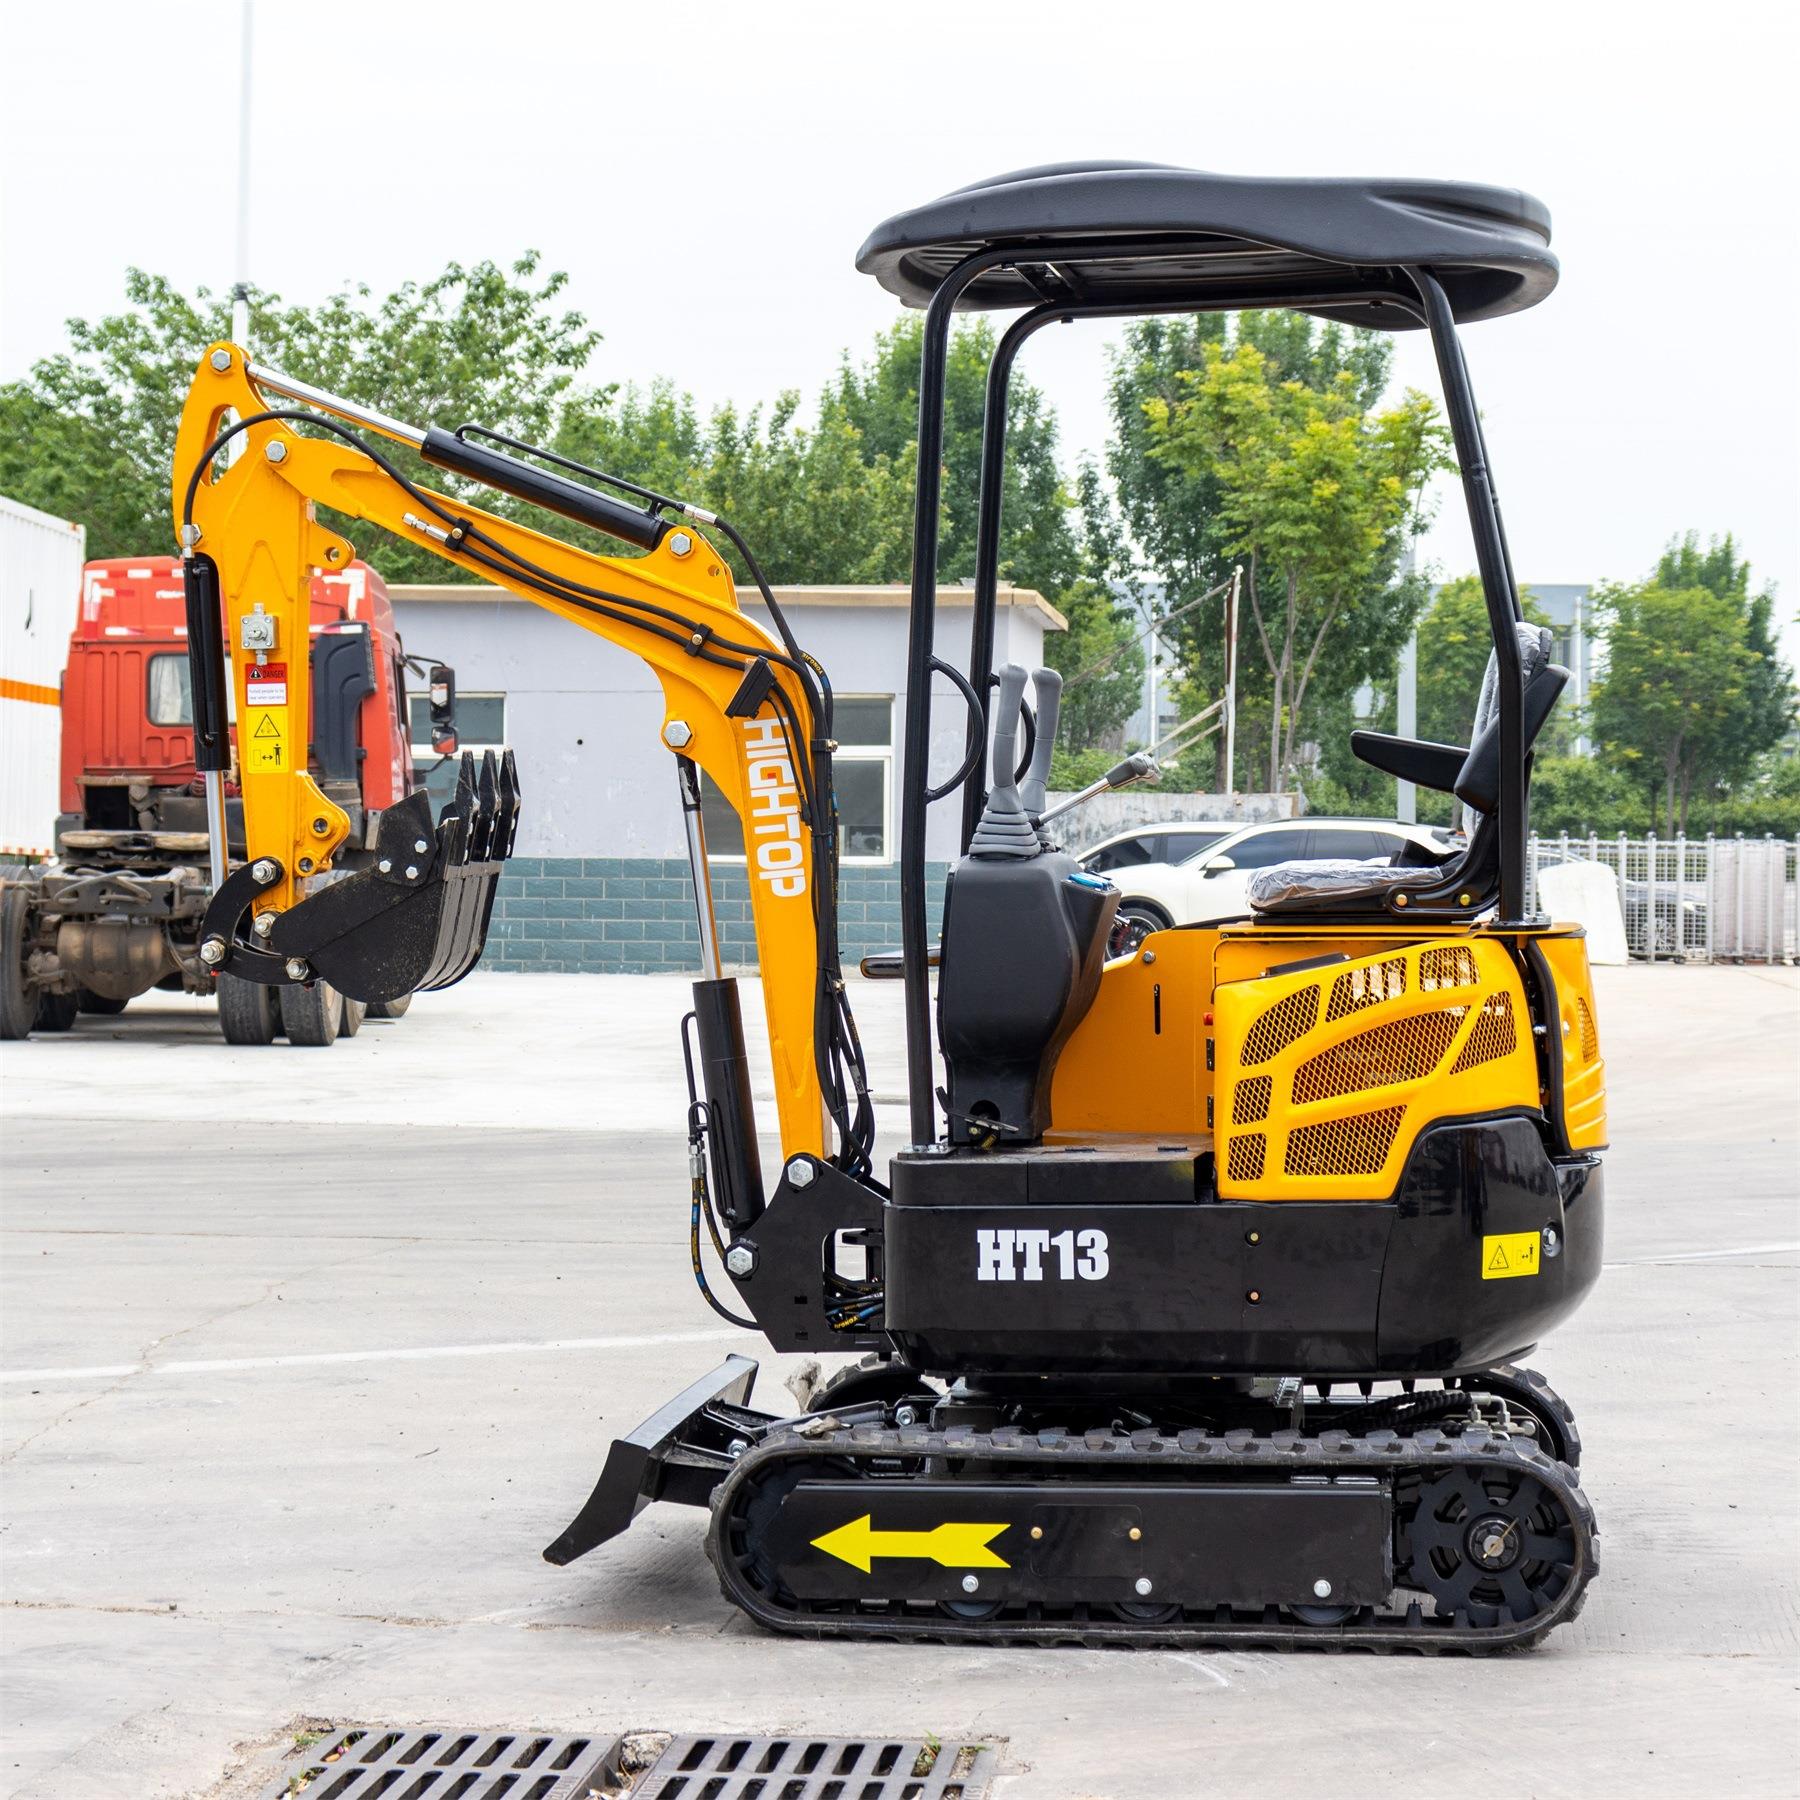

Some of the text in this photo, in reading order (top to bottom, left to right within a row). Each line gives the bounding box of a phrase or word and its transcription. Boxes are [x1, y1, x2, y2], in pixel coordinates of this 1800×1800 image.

[262, 670, 285, 678] DANGER
[743, 717, 806, 897] HIGHTOP
[976, 1229, 1110, 1281] HT13
